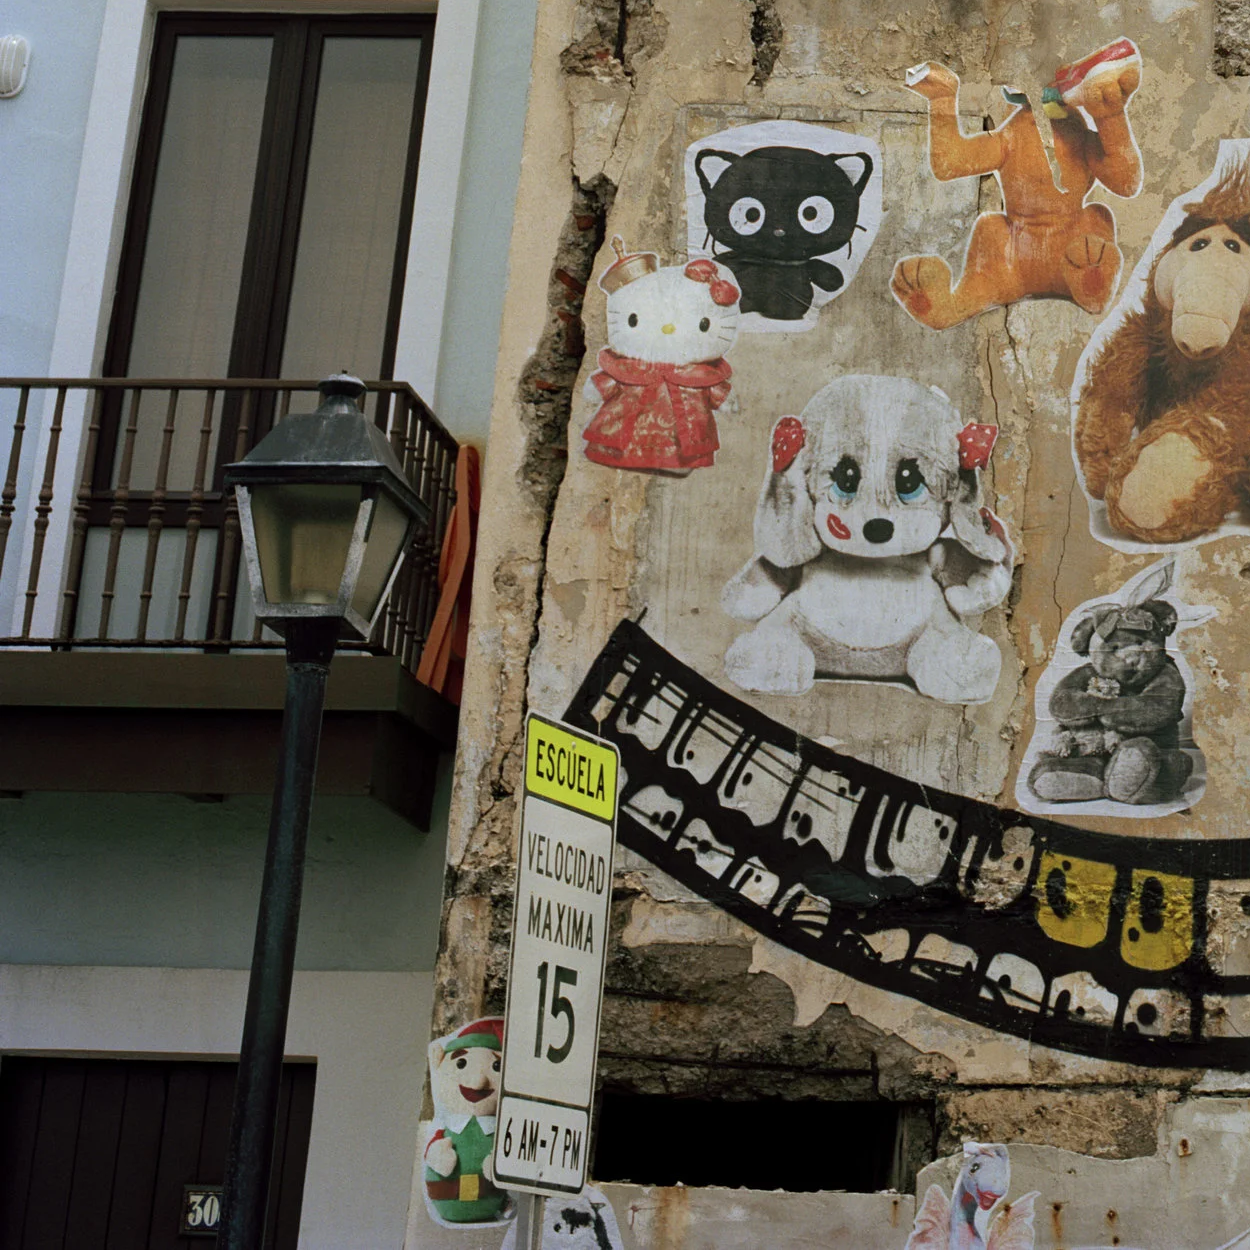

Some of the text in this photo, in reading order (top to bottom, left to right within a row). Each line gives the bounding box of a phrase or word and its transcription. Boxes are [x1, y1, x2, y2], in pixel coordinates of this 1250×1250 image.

[536, 738, 605, 802] ESCUELA
[528, 830, 605, 895] VELOCIDAD
[527, 893, 593, 954] MAXIMA
[534, 961, 578, 1064] 15
[503, 1117, 513, 1158] 6
[562, 1128, 582, 1171] PM
[187, 1194, 221, 1227] 30
